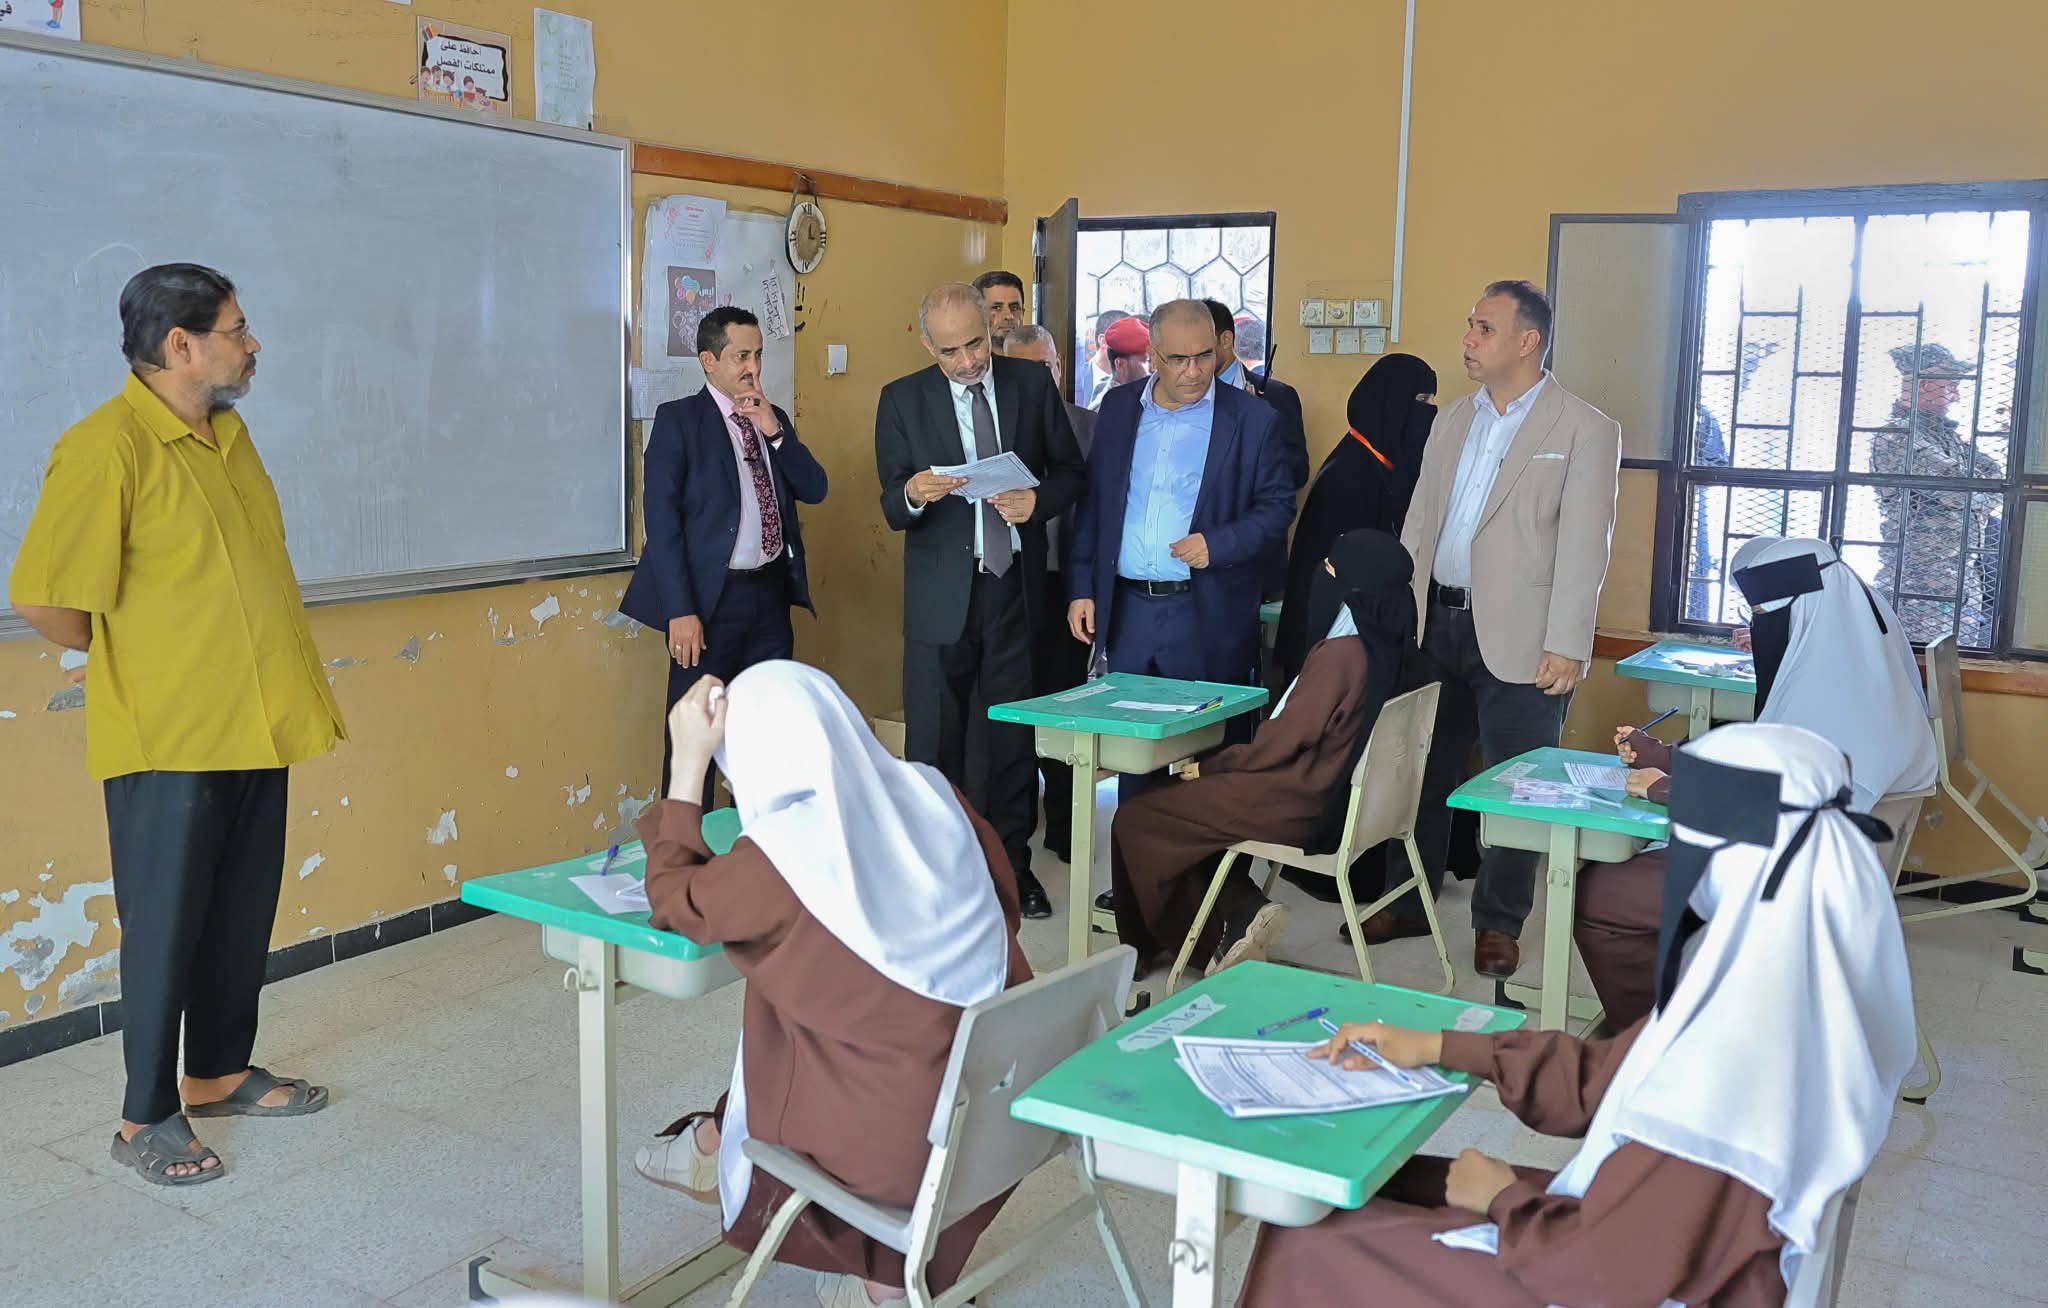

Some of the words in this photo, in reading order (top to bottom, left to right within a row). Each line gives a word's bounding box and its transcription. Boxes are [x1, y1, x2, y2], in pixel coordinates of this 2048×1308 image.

[440, 40, 457, 52] على
[436, 56, 463, 69] الفصل
[463, 61, 496, 75] ممتلكات
